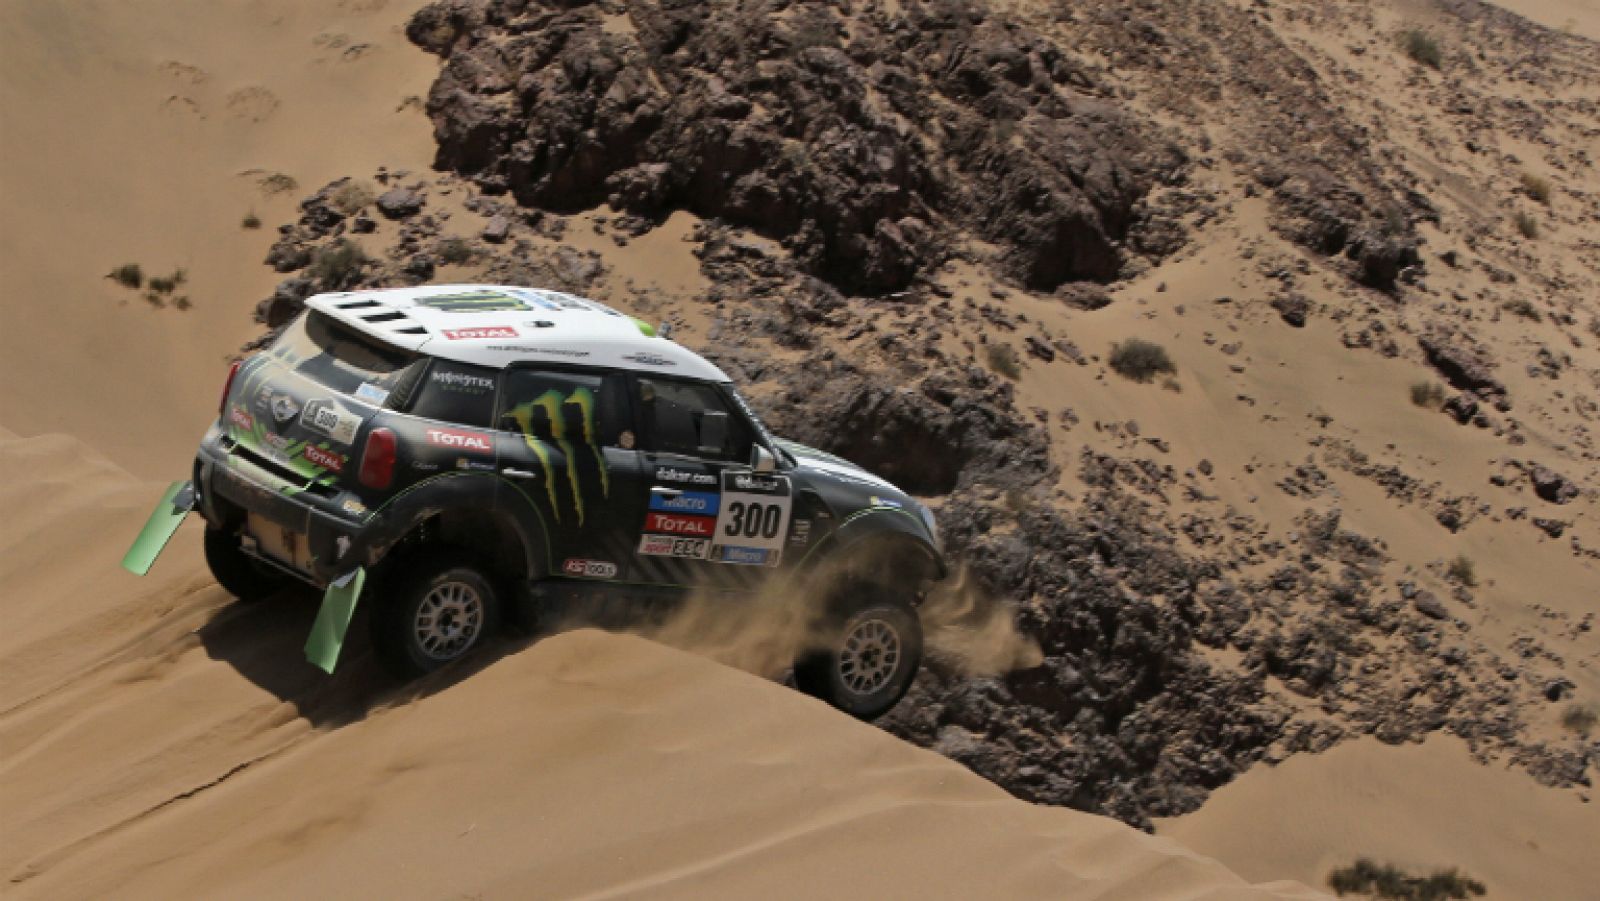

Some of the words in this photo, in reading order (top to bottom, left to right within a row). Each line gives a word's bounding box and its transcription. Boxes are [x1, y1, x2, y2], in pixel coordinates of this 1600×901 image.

[429, 431, 490, 449] TOTAL
[304, 446, 341, 471] TOTAL
[655, 514, 706, 533] TOTAL
[724, 500, 781, 539] 300
